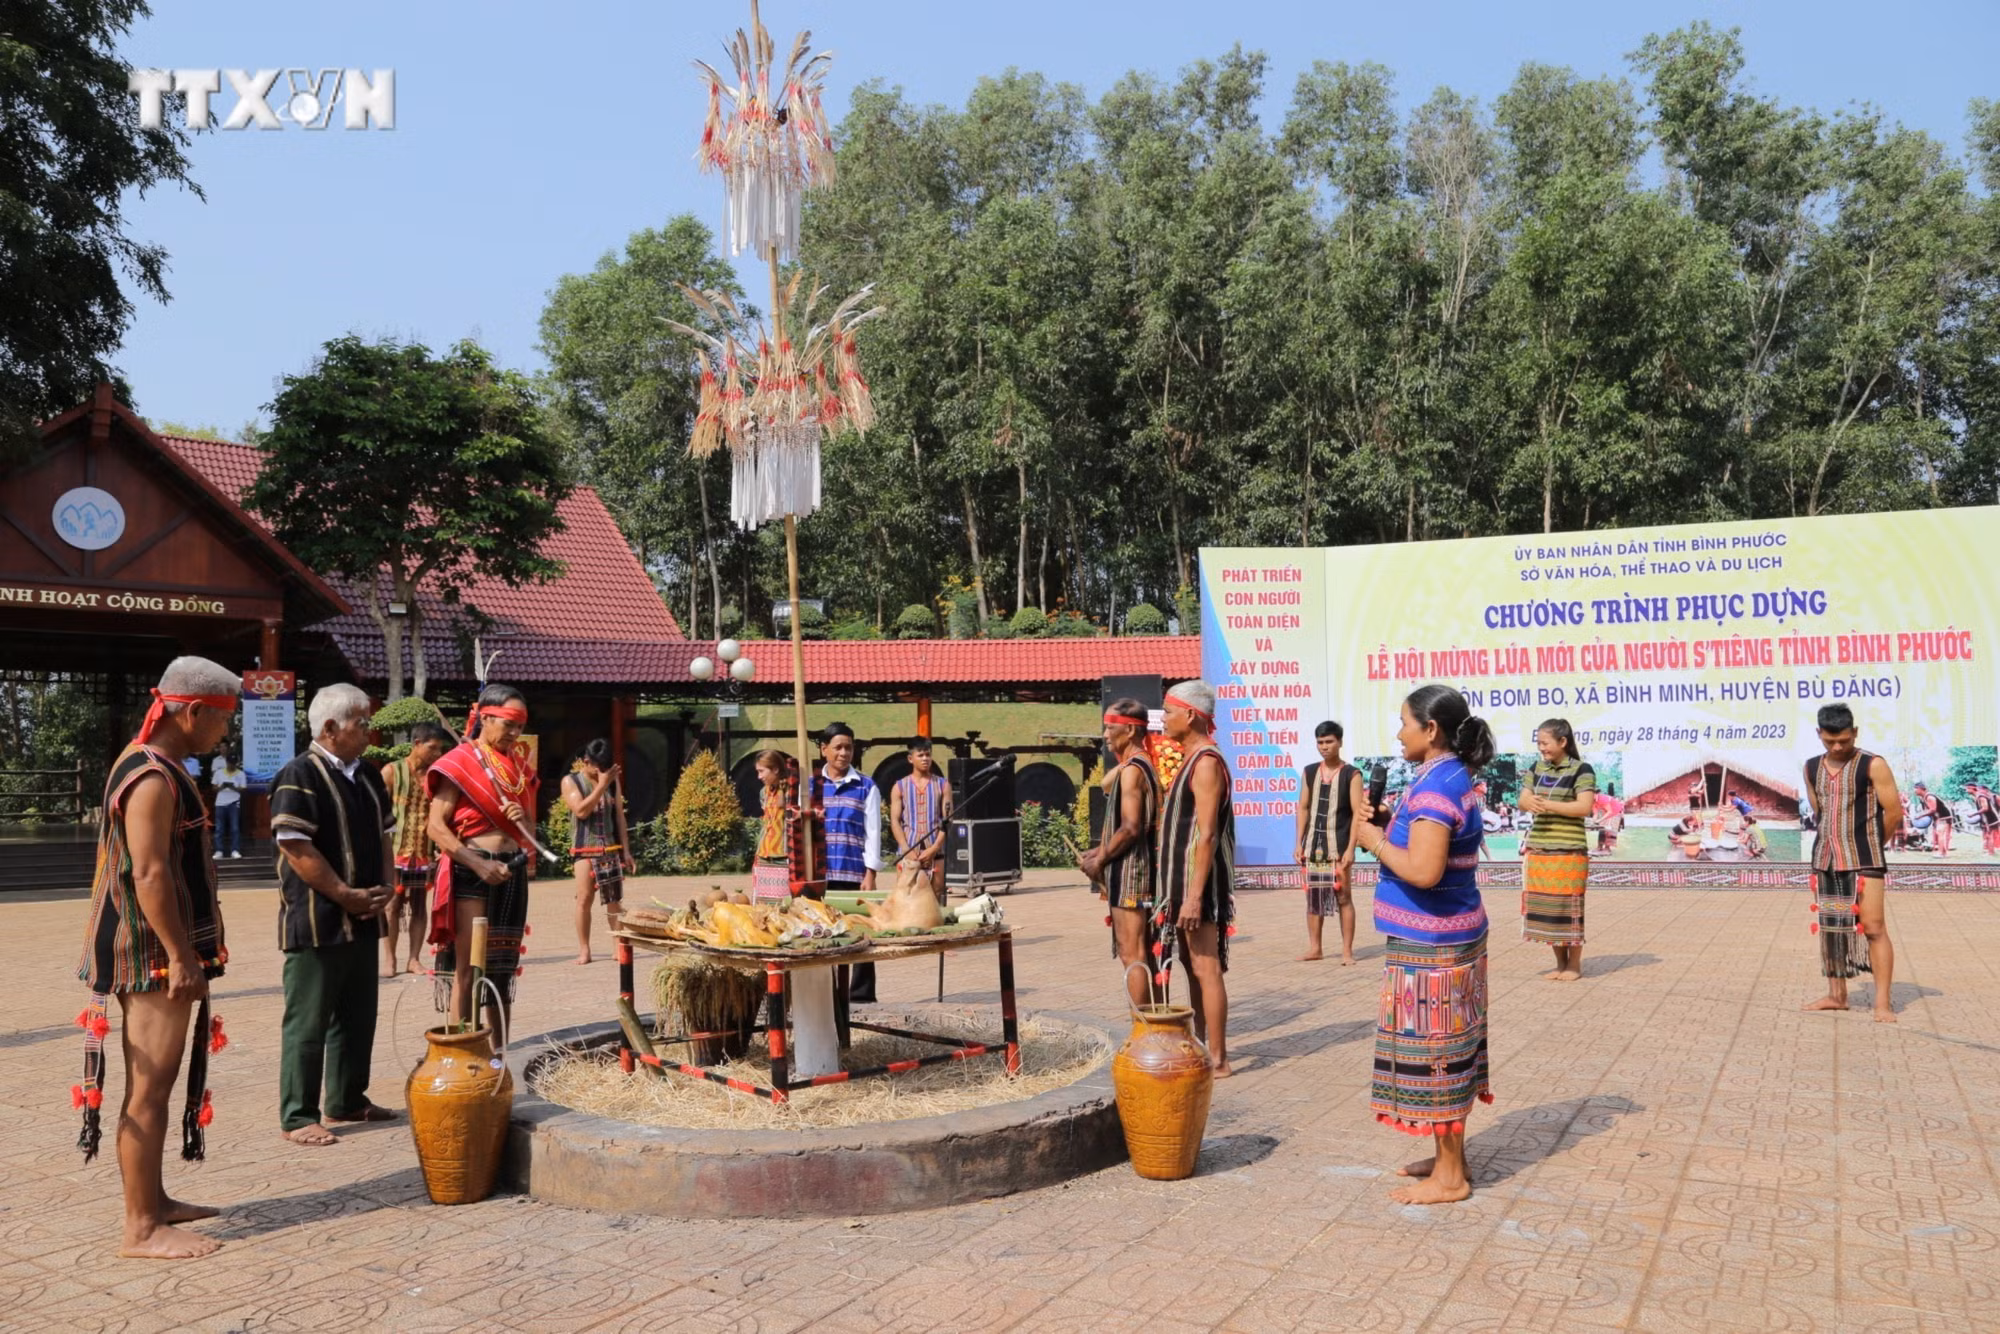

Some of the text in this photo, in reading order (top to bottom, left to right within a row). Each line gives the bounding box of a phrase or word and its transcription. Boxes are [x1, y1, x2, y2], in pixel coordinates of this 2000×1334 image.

[1515, 532, 1787, 561] ỦY BAN NHÂN DÂN TỈNH BÌNH PHƯỚC
[1222, 567, 1257, 582] PHÁT
[1521, 556, 1782, 581] SỞ VĂN HÓA, THỂ THAO VÀ DU LỊCH
[0, 587, 225, 614] NH HOẠT CỘNG ĐỒNG
[1225, 589, 1300, 605] CON NGƯỜI
[1484, 586, 1827, 629] CHƯƠNG TRÌNH PHỤC DỰNG
[1226, 612, 1300, 631] TOÀN DIỆN
[1255, 636, 1273, 651] VÀ
[1367, 625, 1973, 683] LỄ HỘI MỪNG LÚA MỚI CỦA NGƯỜI S'TIÊNG TỈNH BÌNH PHƯỚC
[1230, 659, 1299, 678] XÂY DỰNG
[1251, 683, 1279, 698] VĂN
[1284, 682, 1311, 698] HÓA
[1490, 689, 1531, 707] BOM
[1538, 687, 1568, 708] BO,
[1575, 682, 1600, 704] XÃ
[1606, 680, 1652, 703] BÌNH
[1659, 683, 1714, 704] MINH,
[1721, 677, 1790, 703] HUYỆN
[1797, 675, 1826, 698] BÙ
[1832, 673, 1902, 699] ĐĂNG)
[1232, 706, 1298, 725] VIỆT NAM
[1232, 727, 1298, 745] TIÊN TIẾN
[1599, 727, 1633, 745] ngày
[1637, 727, 1654, 741] 28
[1658, 725, 1699, 744] tháng
[1703, 725, 1712, 740] 4
[1716, 725, 1747, 739] năm
[1752, 724, 1787, 739] 2023
[1238, 752, 1293, 772] ĐẬM ĐÀ
[1235, 773, 1297, 792] BẢN SẮC
[1233, 800, 1263, 816] DÂN
